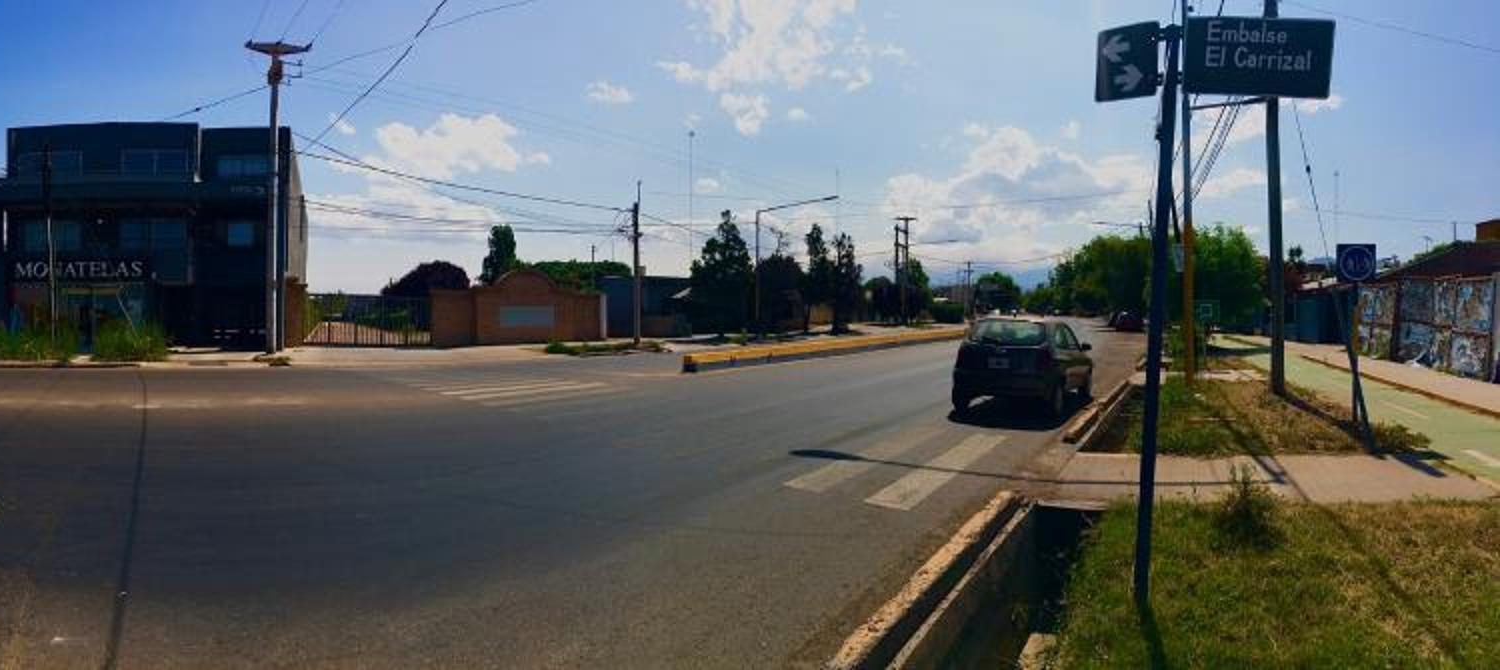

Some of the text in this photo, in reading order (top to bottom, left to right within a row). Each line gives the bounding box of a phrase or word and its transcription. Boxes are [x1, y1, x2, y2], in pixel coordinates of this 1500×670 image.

[1206, 20, 1288, 44] Embalse
[1204, 46, 1312, 72] El Carrizal
